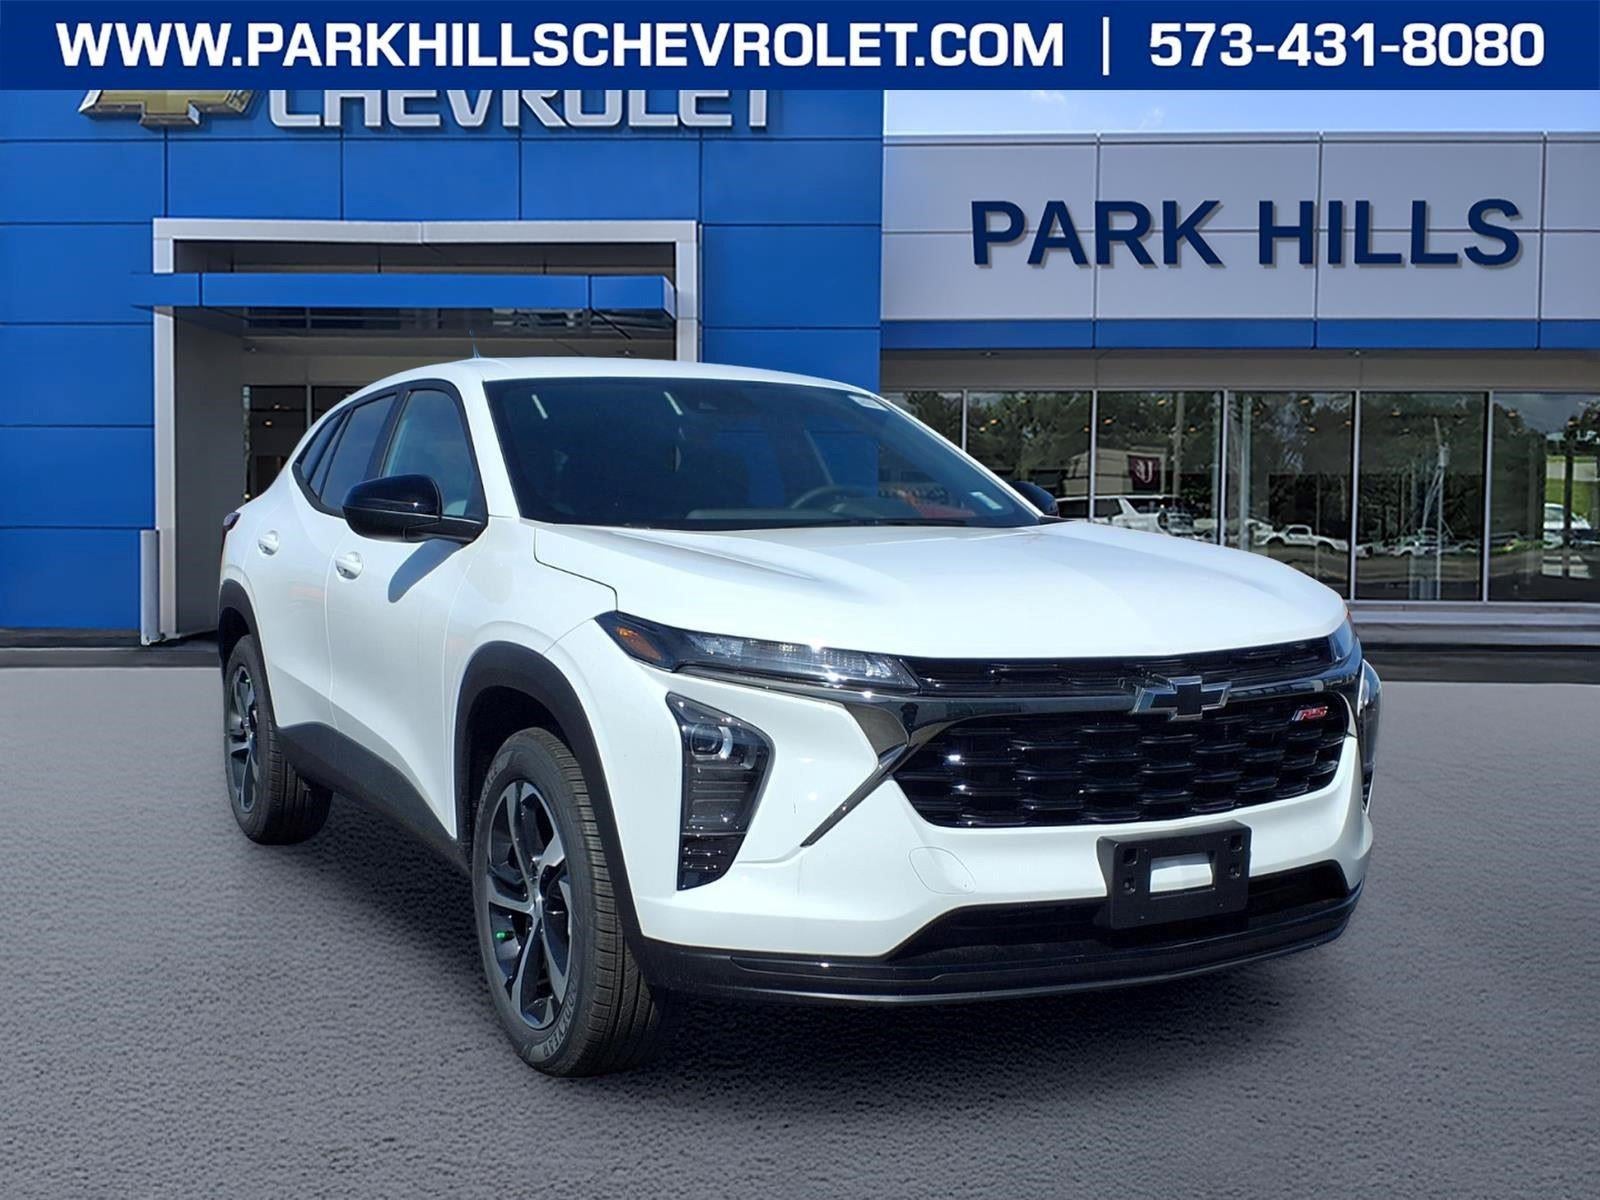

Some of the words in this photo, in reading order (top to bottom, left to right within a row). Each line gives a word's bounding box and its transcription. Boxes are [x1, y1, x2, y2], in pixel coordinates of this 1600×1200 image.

[971, 200, 1222, 266] PARK
[1259, 198, 1520, 266] HILLS
[1292, 706, 1328, 721] RS
